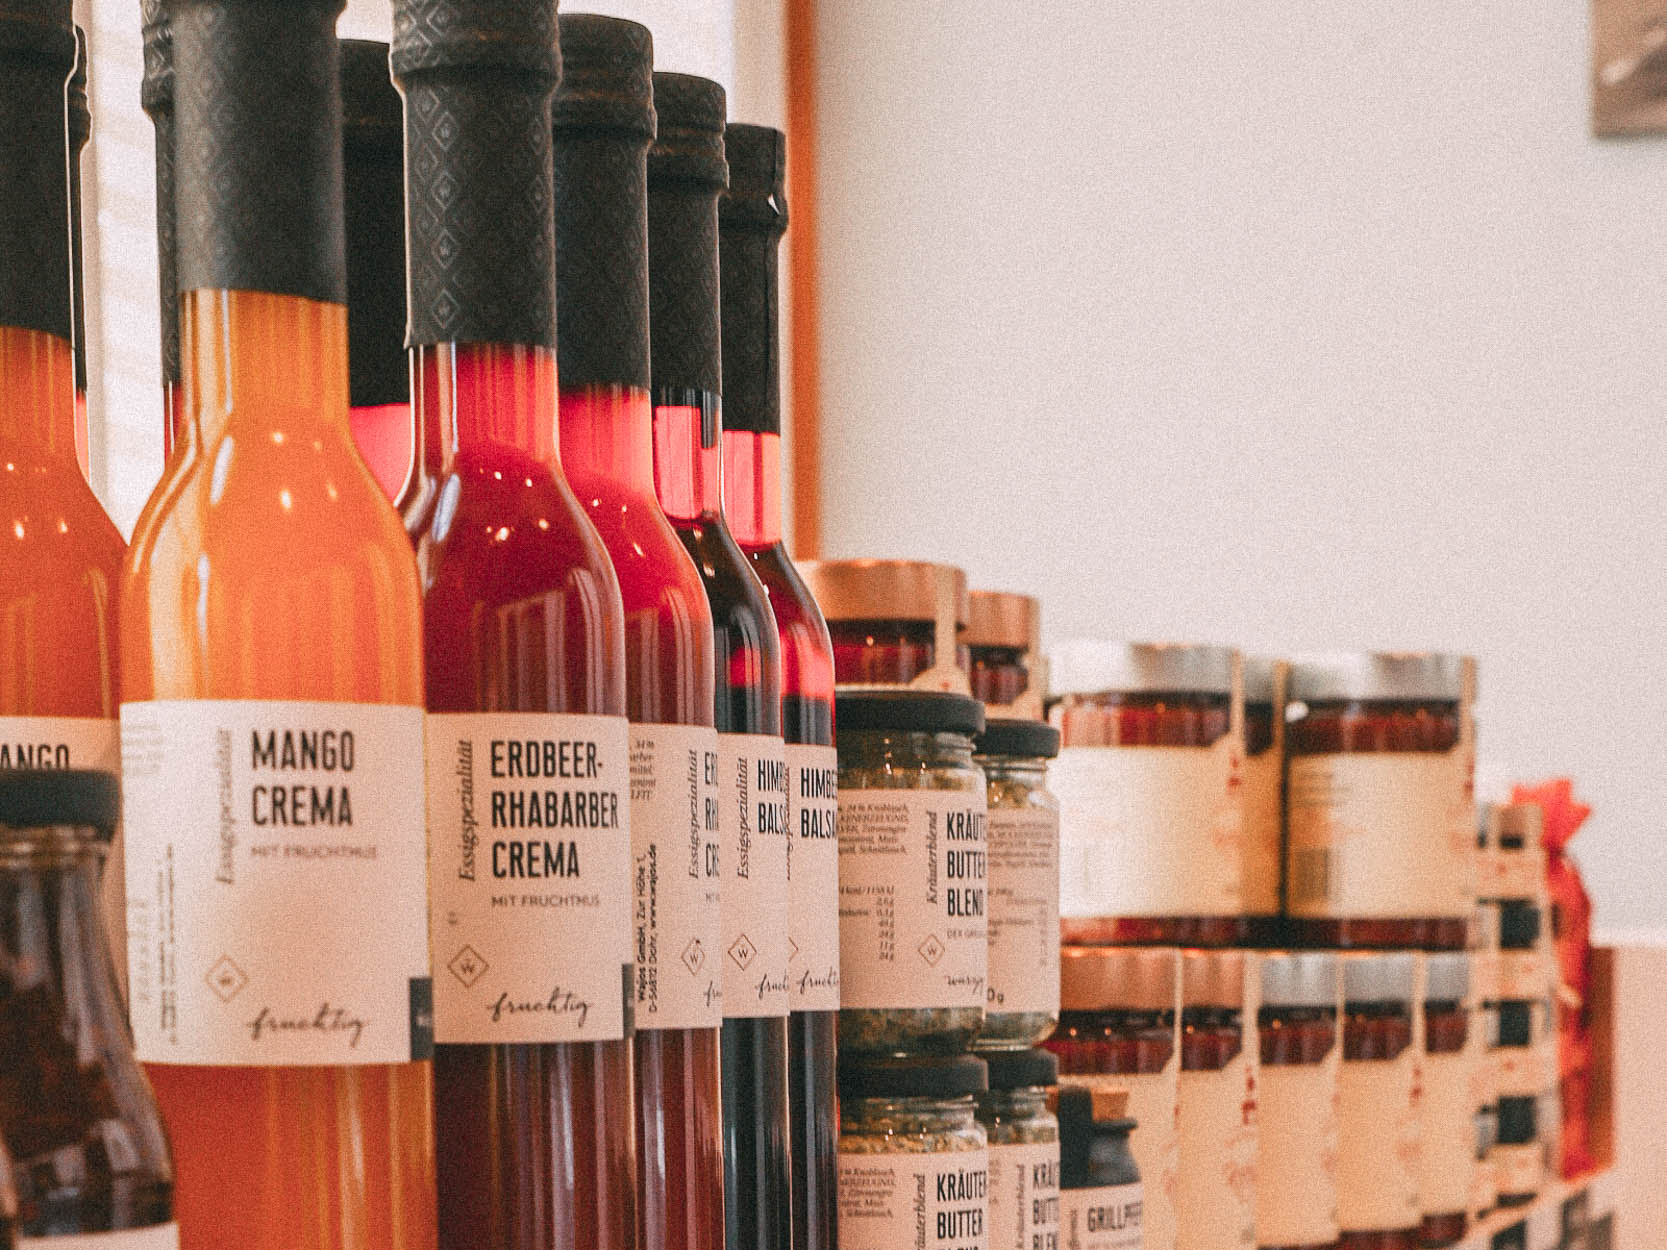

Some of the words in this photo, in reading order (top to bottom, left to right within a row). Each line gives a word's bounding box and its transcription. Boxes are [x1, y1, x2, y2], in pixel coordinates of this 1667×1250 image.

[251, 730, 355, 771] MANGO
[490, 740, 603, 779] ERDBEER-
[252, 786, 353, 827] CREMA
[456, 739, 479, 882] Essigspezialität
[491, 791, 620, 830] RHABARBER
[736, 757, 751, 880] Essigspezialität
[491, 841, 580, 879] CREMA
[491, 894, 517, 908] MIT
[521, 894, 601, 908] FRUCHTMUS
[246, 1003, 369, 1048] fruchtig
[486, 986, 595, 1028] fruchtig
[937, 1208, 983, 1239] BUTTER
